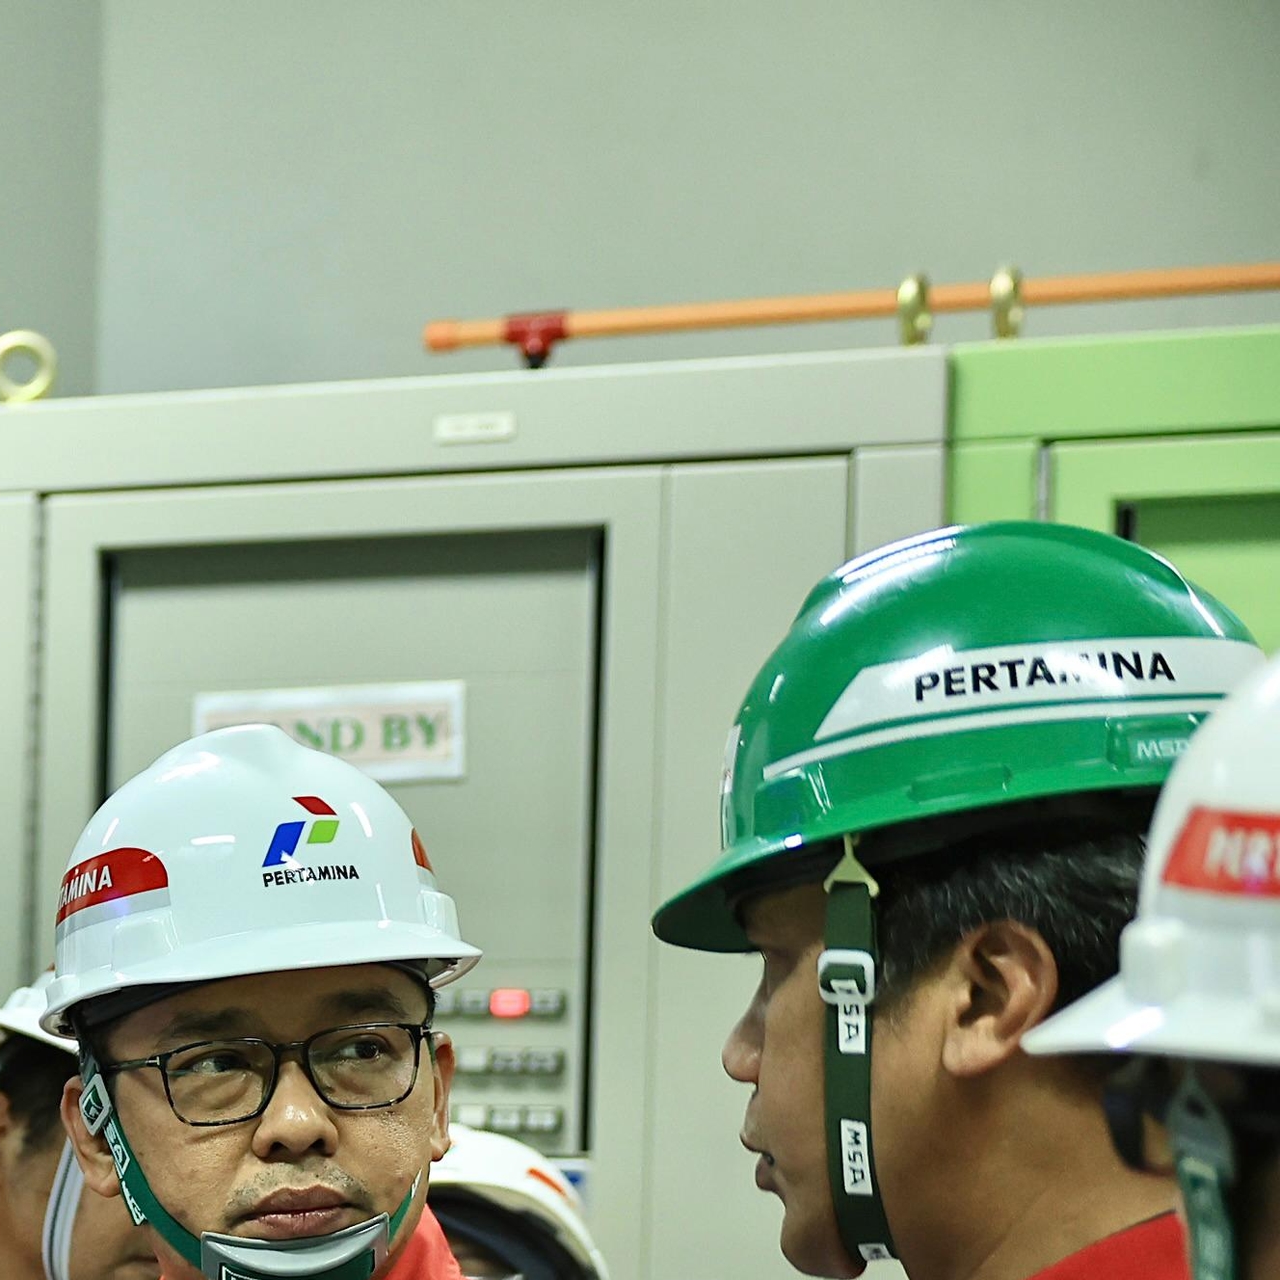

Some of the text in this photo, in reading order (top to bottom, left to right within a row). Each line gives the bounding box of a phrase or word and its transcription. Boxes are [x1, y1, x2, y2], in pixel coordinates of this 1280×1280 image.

[914, 651, 1176, 701] PERTAINA
[382, 713, 443, 751] BY
[262, 865, 359, 887] PERTAMINA
[847, 1127, 865, 1185] MSA
